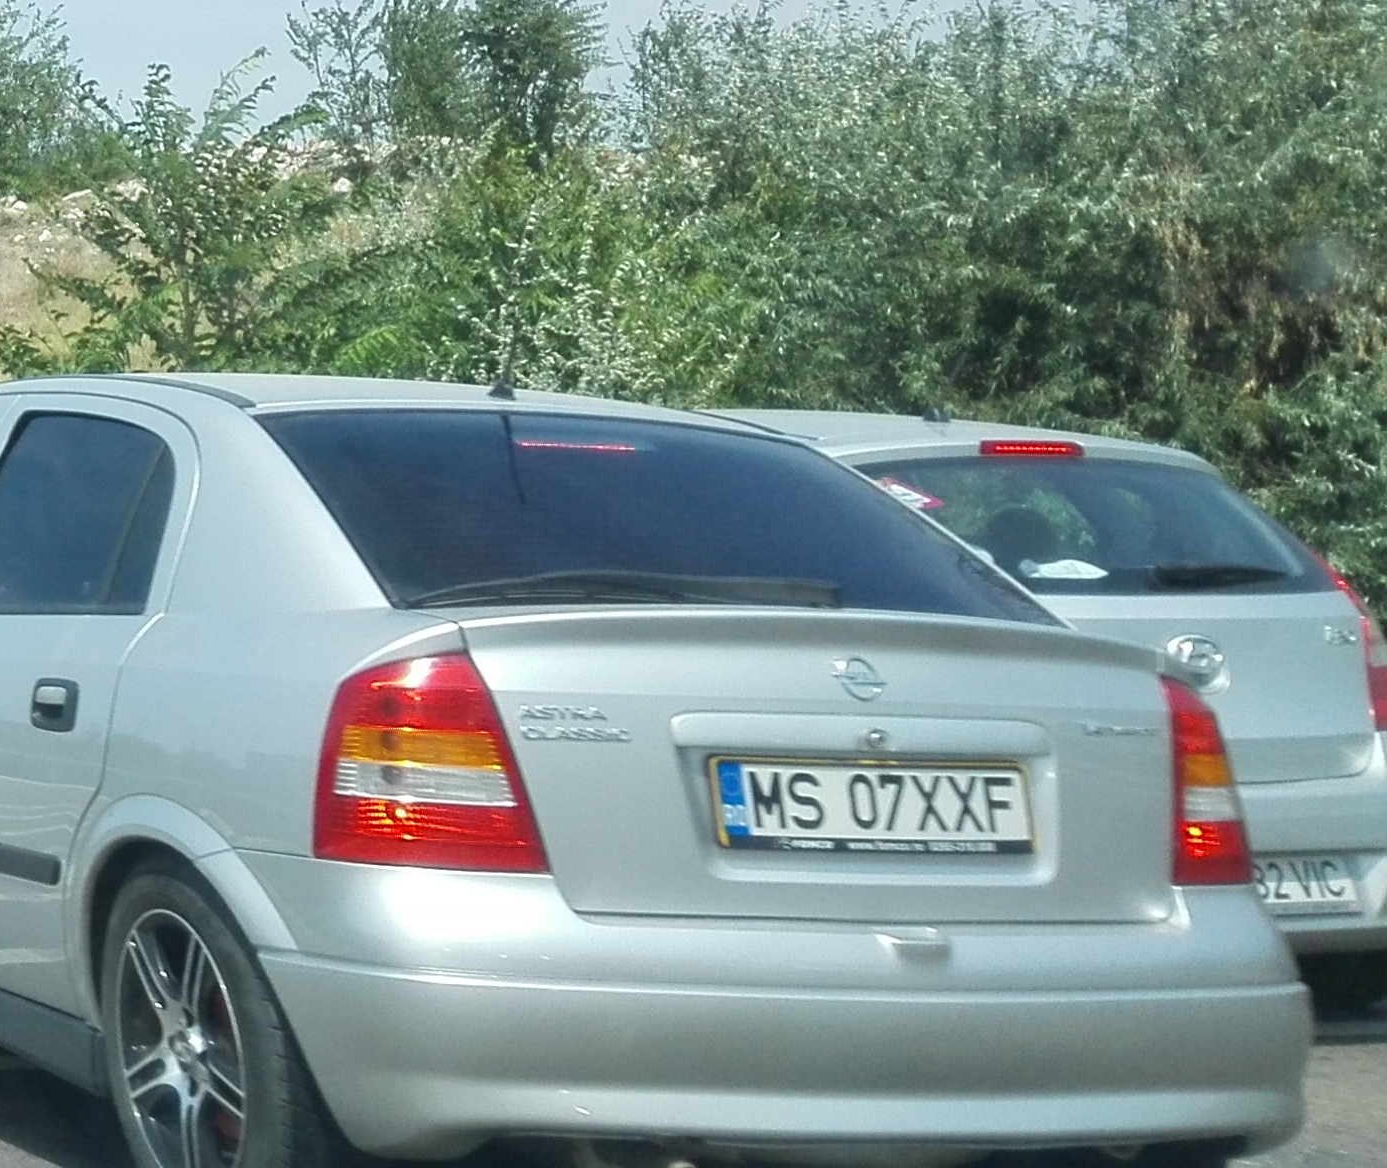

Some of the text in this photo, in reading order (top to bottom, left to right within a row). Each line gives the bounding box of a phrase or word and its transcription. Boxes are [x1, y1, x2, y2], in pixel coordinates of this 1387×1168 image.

[518, 703, 608, 721] ASTRA
[518, 724, 632, 742] CLASSIC
[747, 770, 1014, 833] MS 07XXF
[1289, 859, 1346, 899] VIC
